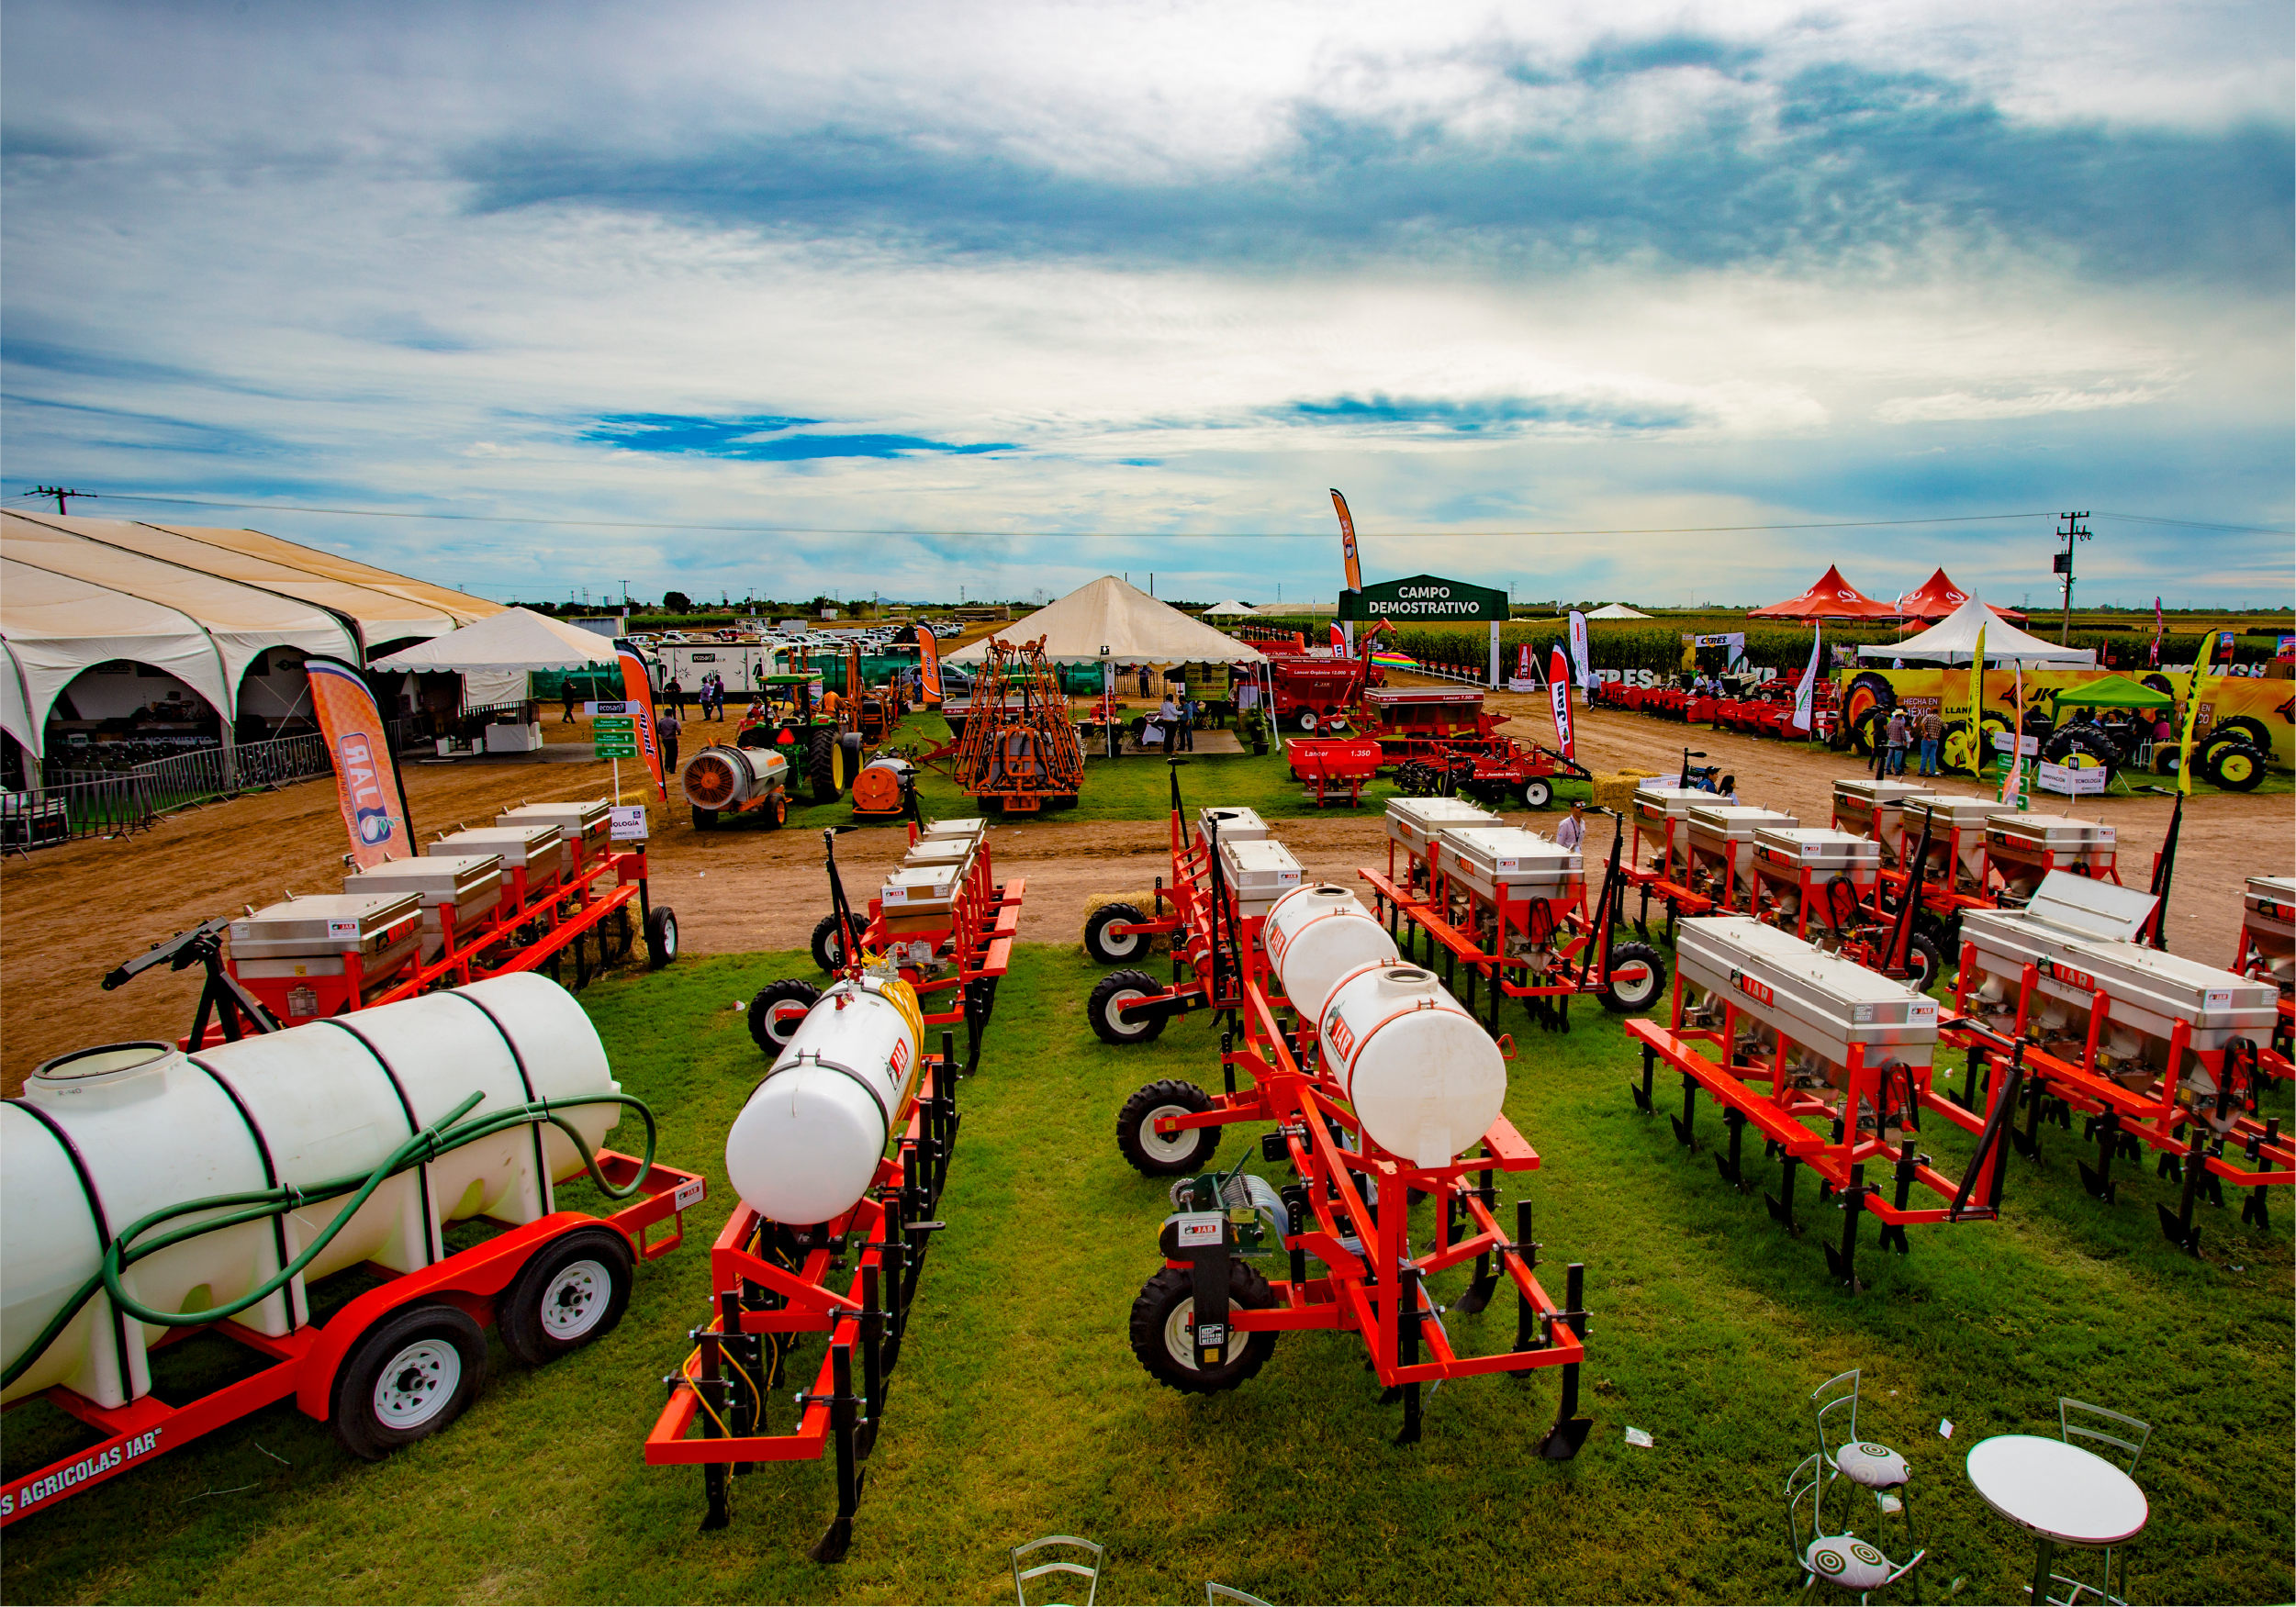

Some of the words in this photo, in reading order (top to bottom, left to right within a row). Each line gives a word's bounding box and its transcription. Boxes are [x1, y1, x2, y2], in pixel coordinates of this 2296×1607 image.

[1398, 586, 1450, 598] CAMPO
[1369, 601, 1480, 614] DEMOSTRATIVO
[599, 703, 622, 712] ecosan
[1557, 683, 1567, 722] Jan
[639, 713, 655, 759] jacto
[2042, 773, 2065, 783] INNOVACIÓN
[1271, 929, 1284, 954] JAR
[2061, 967, 2089, 988] JAR
[1747, 979, 1770, 1003] JAR
[1333, 1023, 1352, 1057] JAR
[893, 1042, 908, 1077] JAR
[19, 1446, 123, 1509] AGRICOLAS
